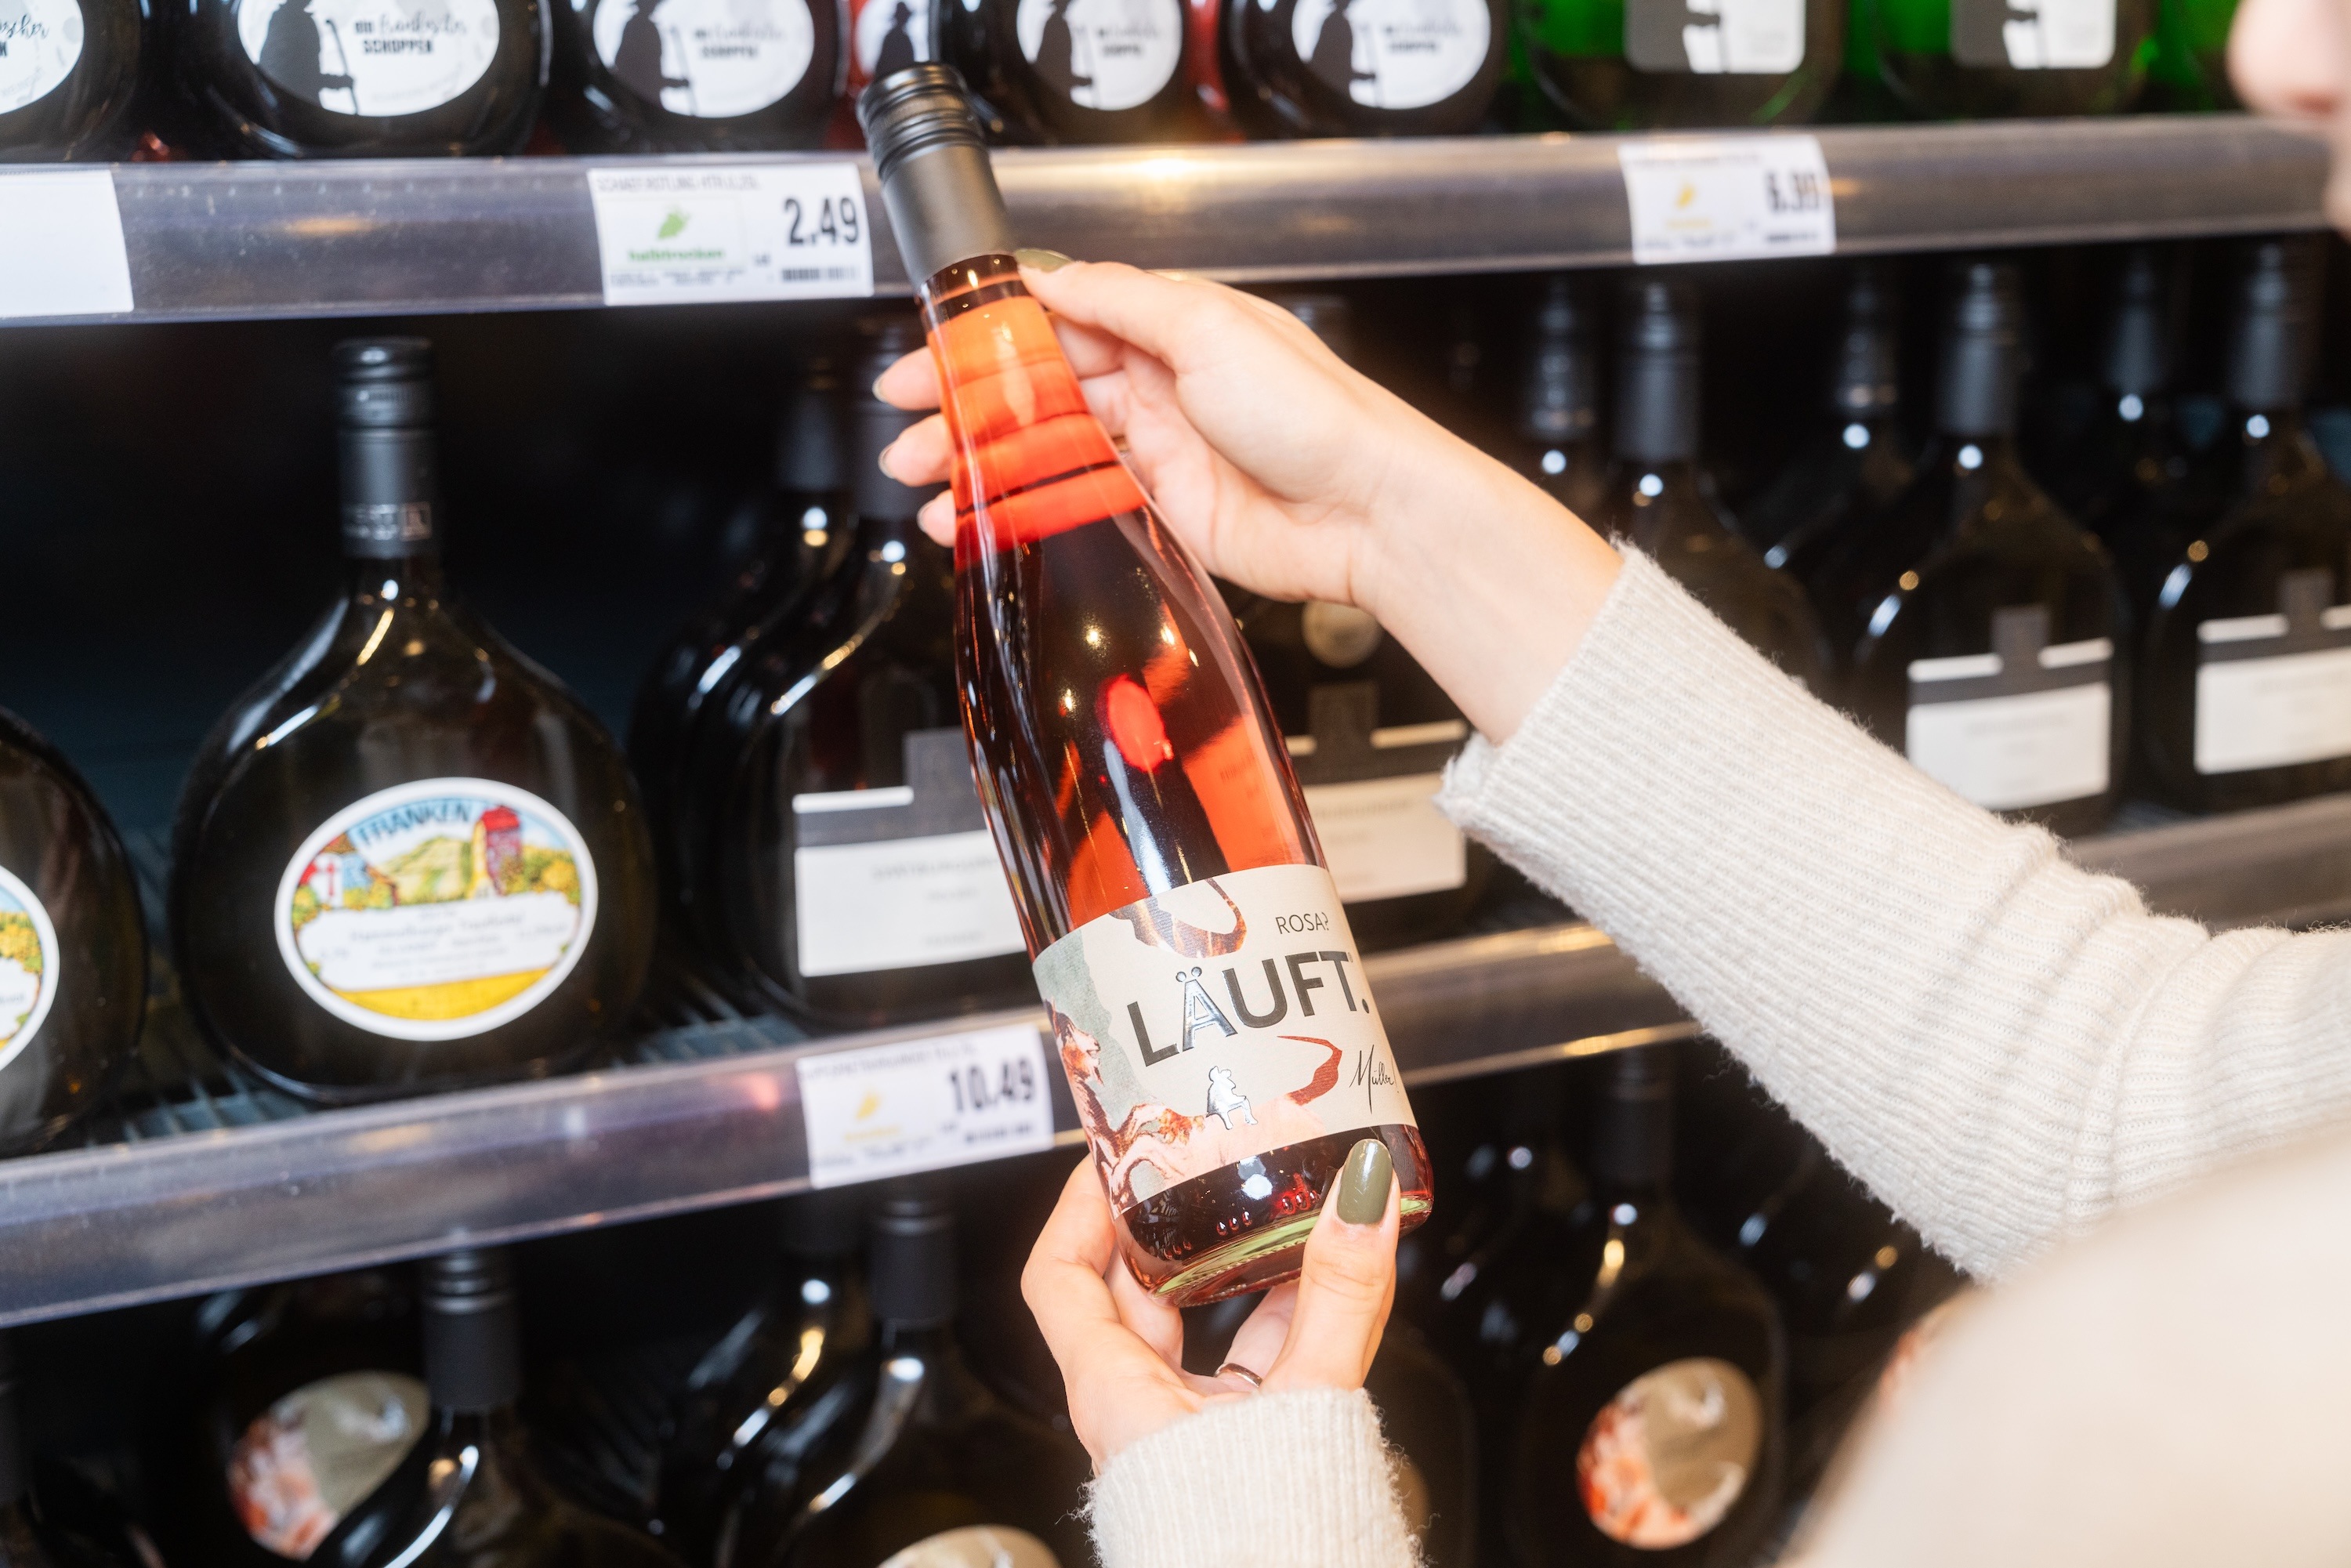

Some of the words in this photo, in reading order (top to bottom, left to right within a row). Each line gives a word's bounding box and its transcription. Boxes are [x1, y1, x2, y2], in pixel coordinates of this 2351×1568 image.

[363, 39, 433, 54] SCHOPPEN
[784, 197, 860, 247] 2.49
[357, 801, 470, 846] FRANKEN
[1275, 911, 1330, 935] ROSA?
[947, 1056, 1037, 1113] 10.49
